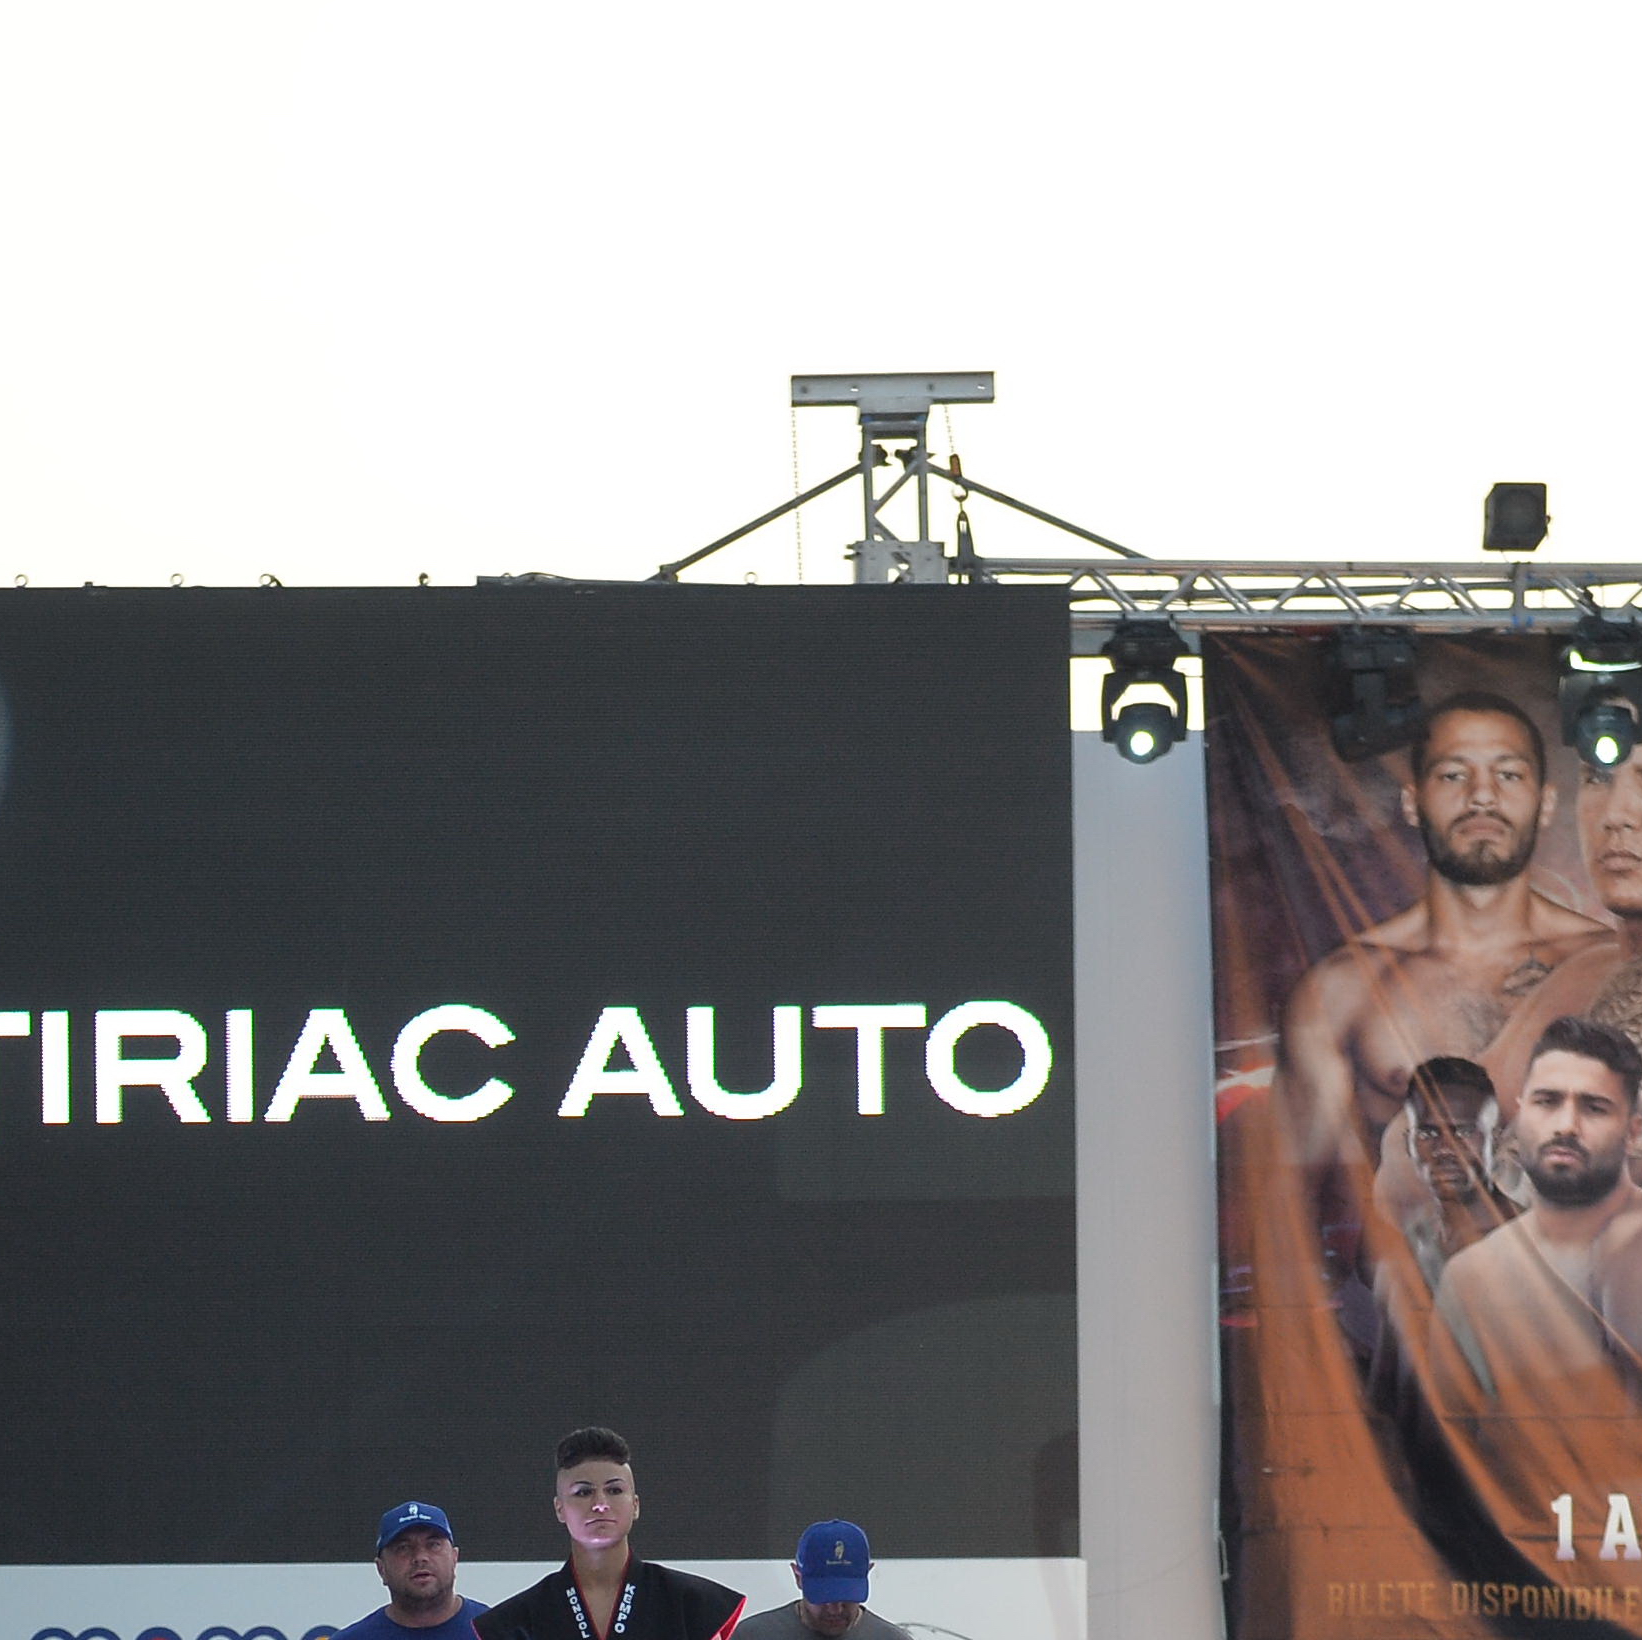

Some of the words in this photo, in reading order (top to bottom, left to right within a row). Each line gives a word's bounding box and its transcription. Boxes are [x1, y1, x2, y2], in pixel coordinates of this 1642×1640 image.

[556, 1000, 1054, 1120] AUTO
[1551, 1493, 1576, 1561] 1
[565, 1586, 591, 1639] MONGOL
[614, 1583, 637, 1634] KEMPO
[1326, 1579, 1437, 1619] BILETE
[1450, 1581, 1641, 1622] DISPONIBILE
